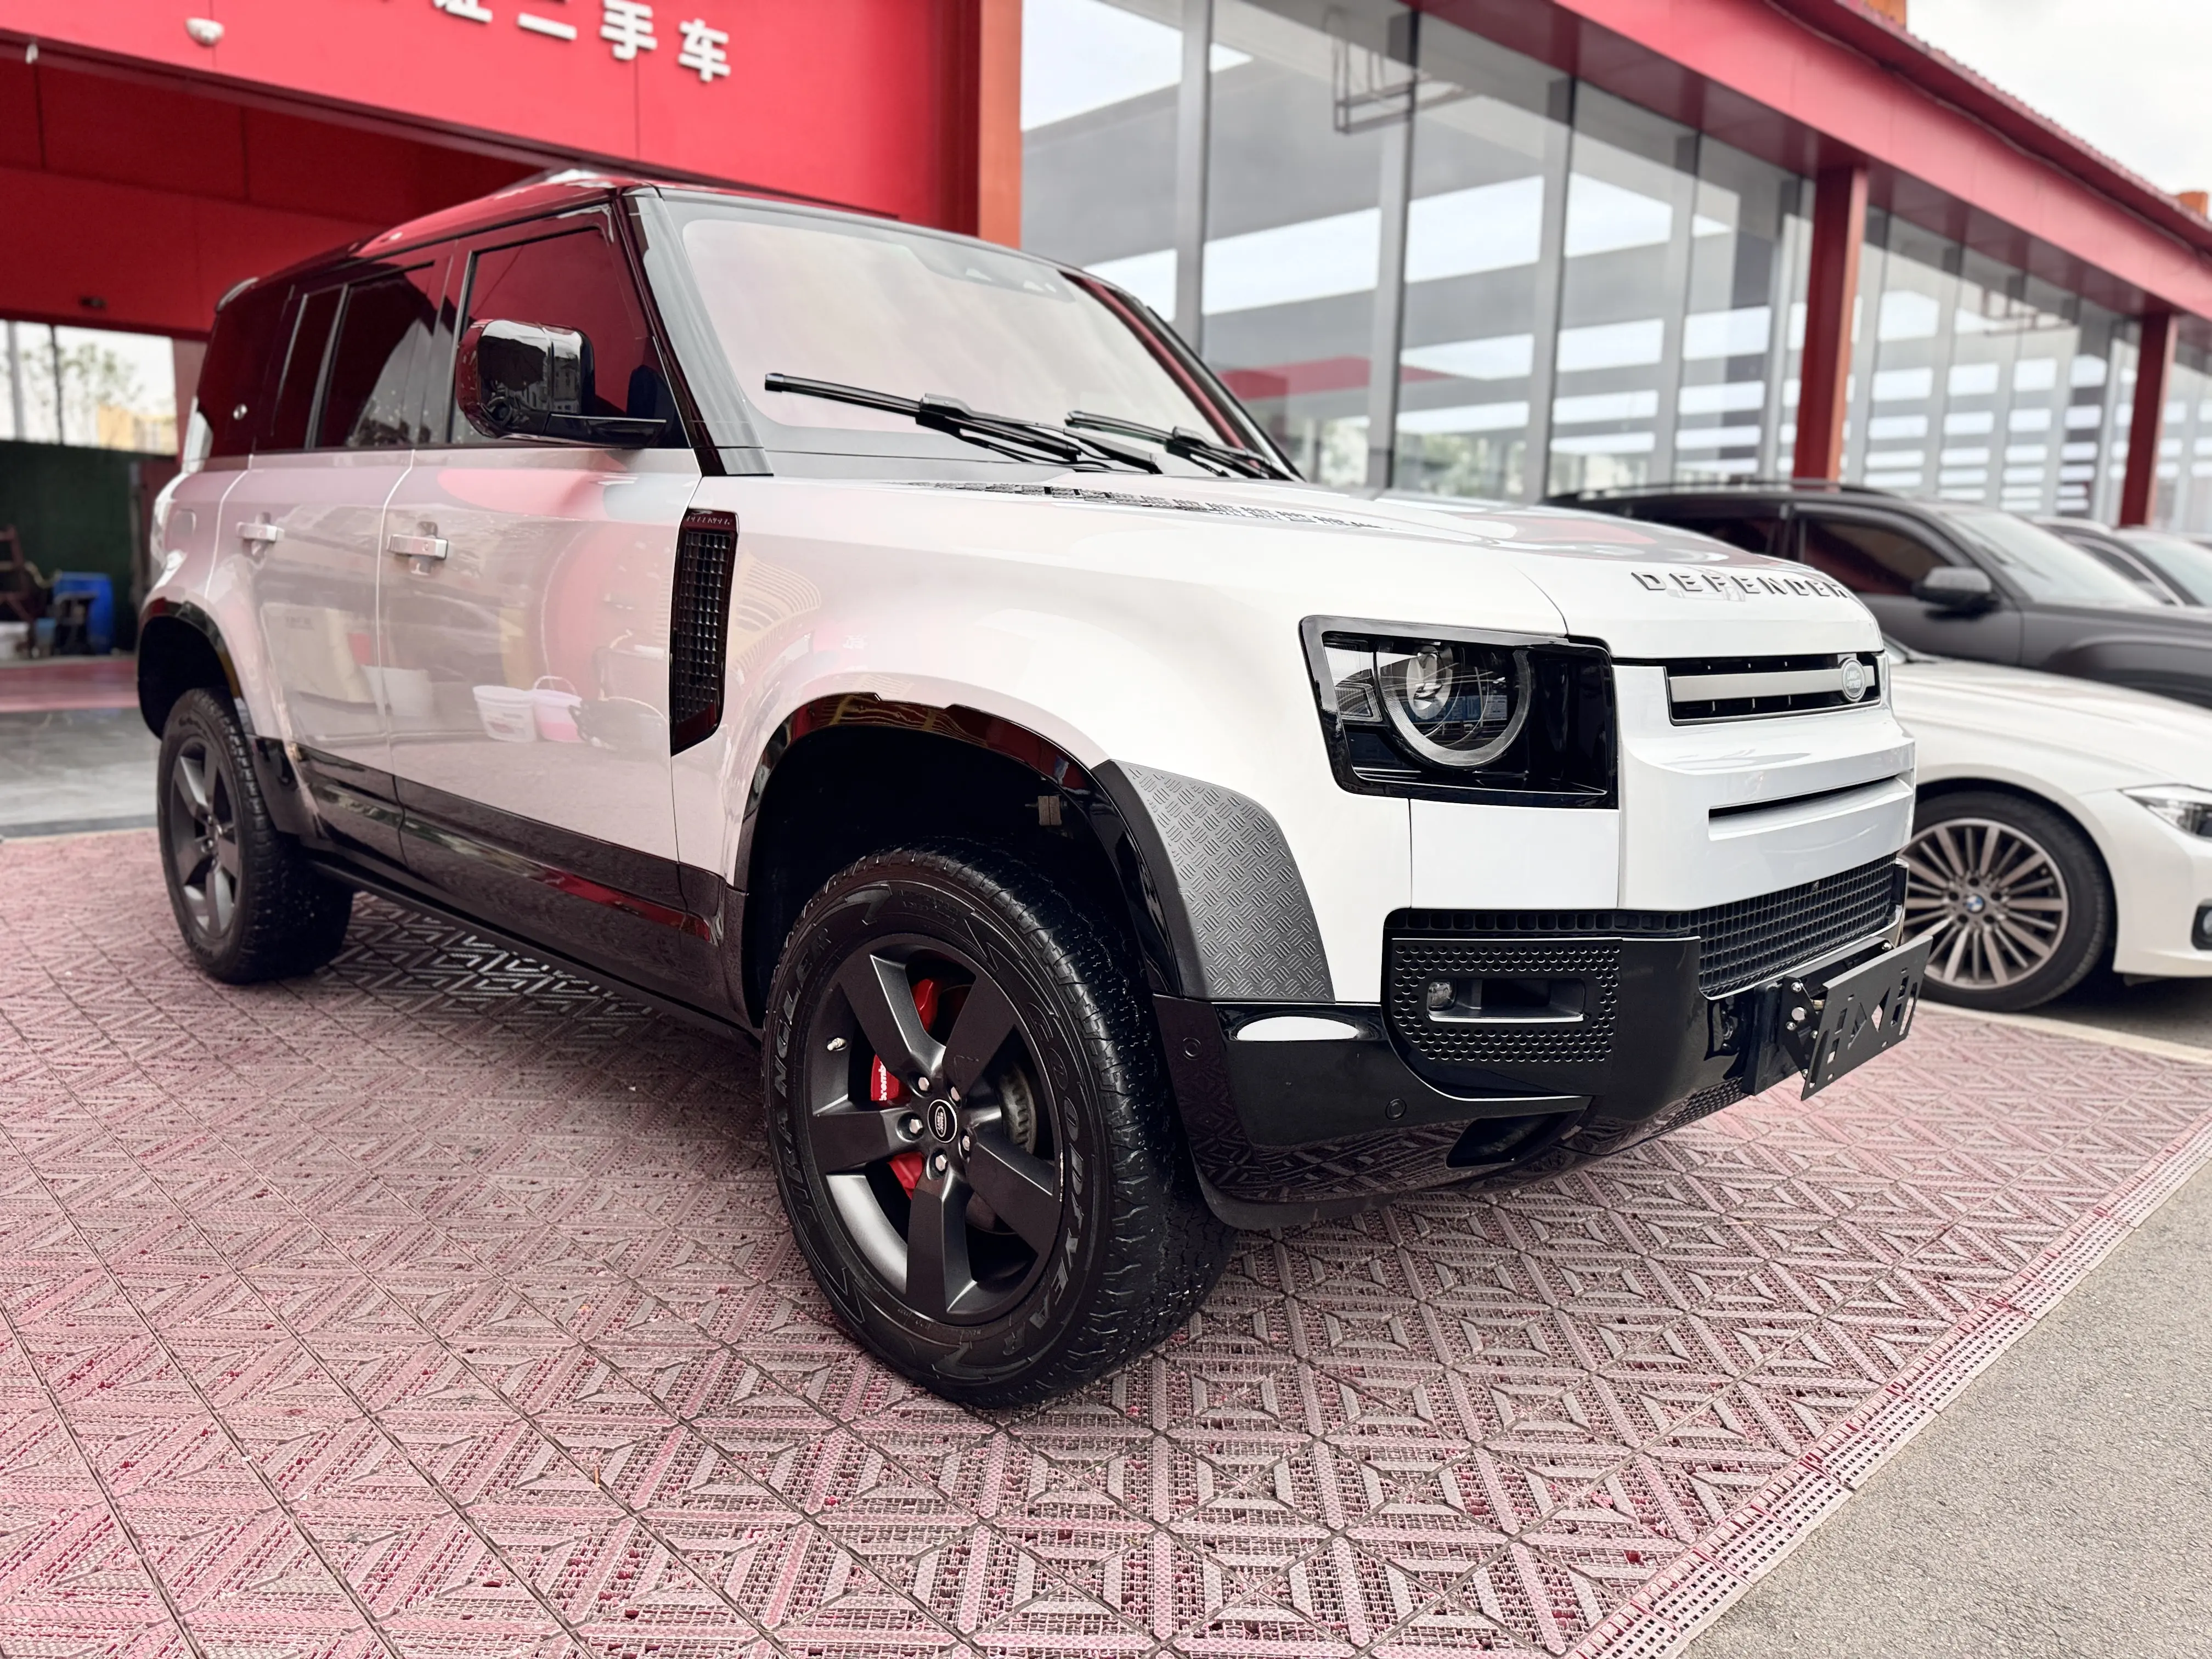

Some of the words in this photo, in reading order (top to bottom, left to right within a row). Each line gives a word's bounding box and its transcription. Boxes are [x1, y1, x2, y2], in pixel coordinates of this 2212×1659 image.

[1631, 572, 1848, 599] DEFENDER
[878, 1060, 887, 1101] bremb
[1002, 1001, 1085, 1356] GOODYEAR
